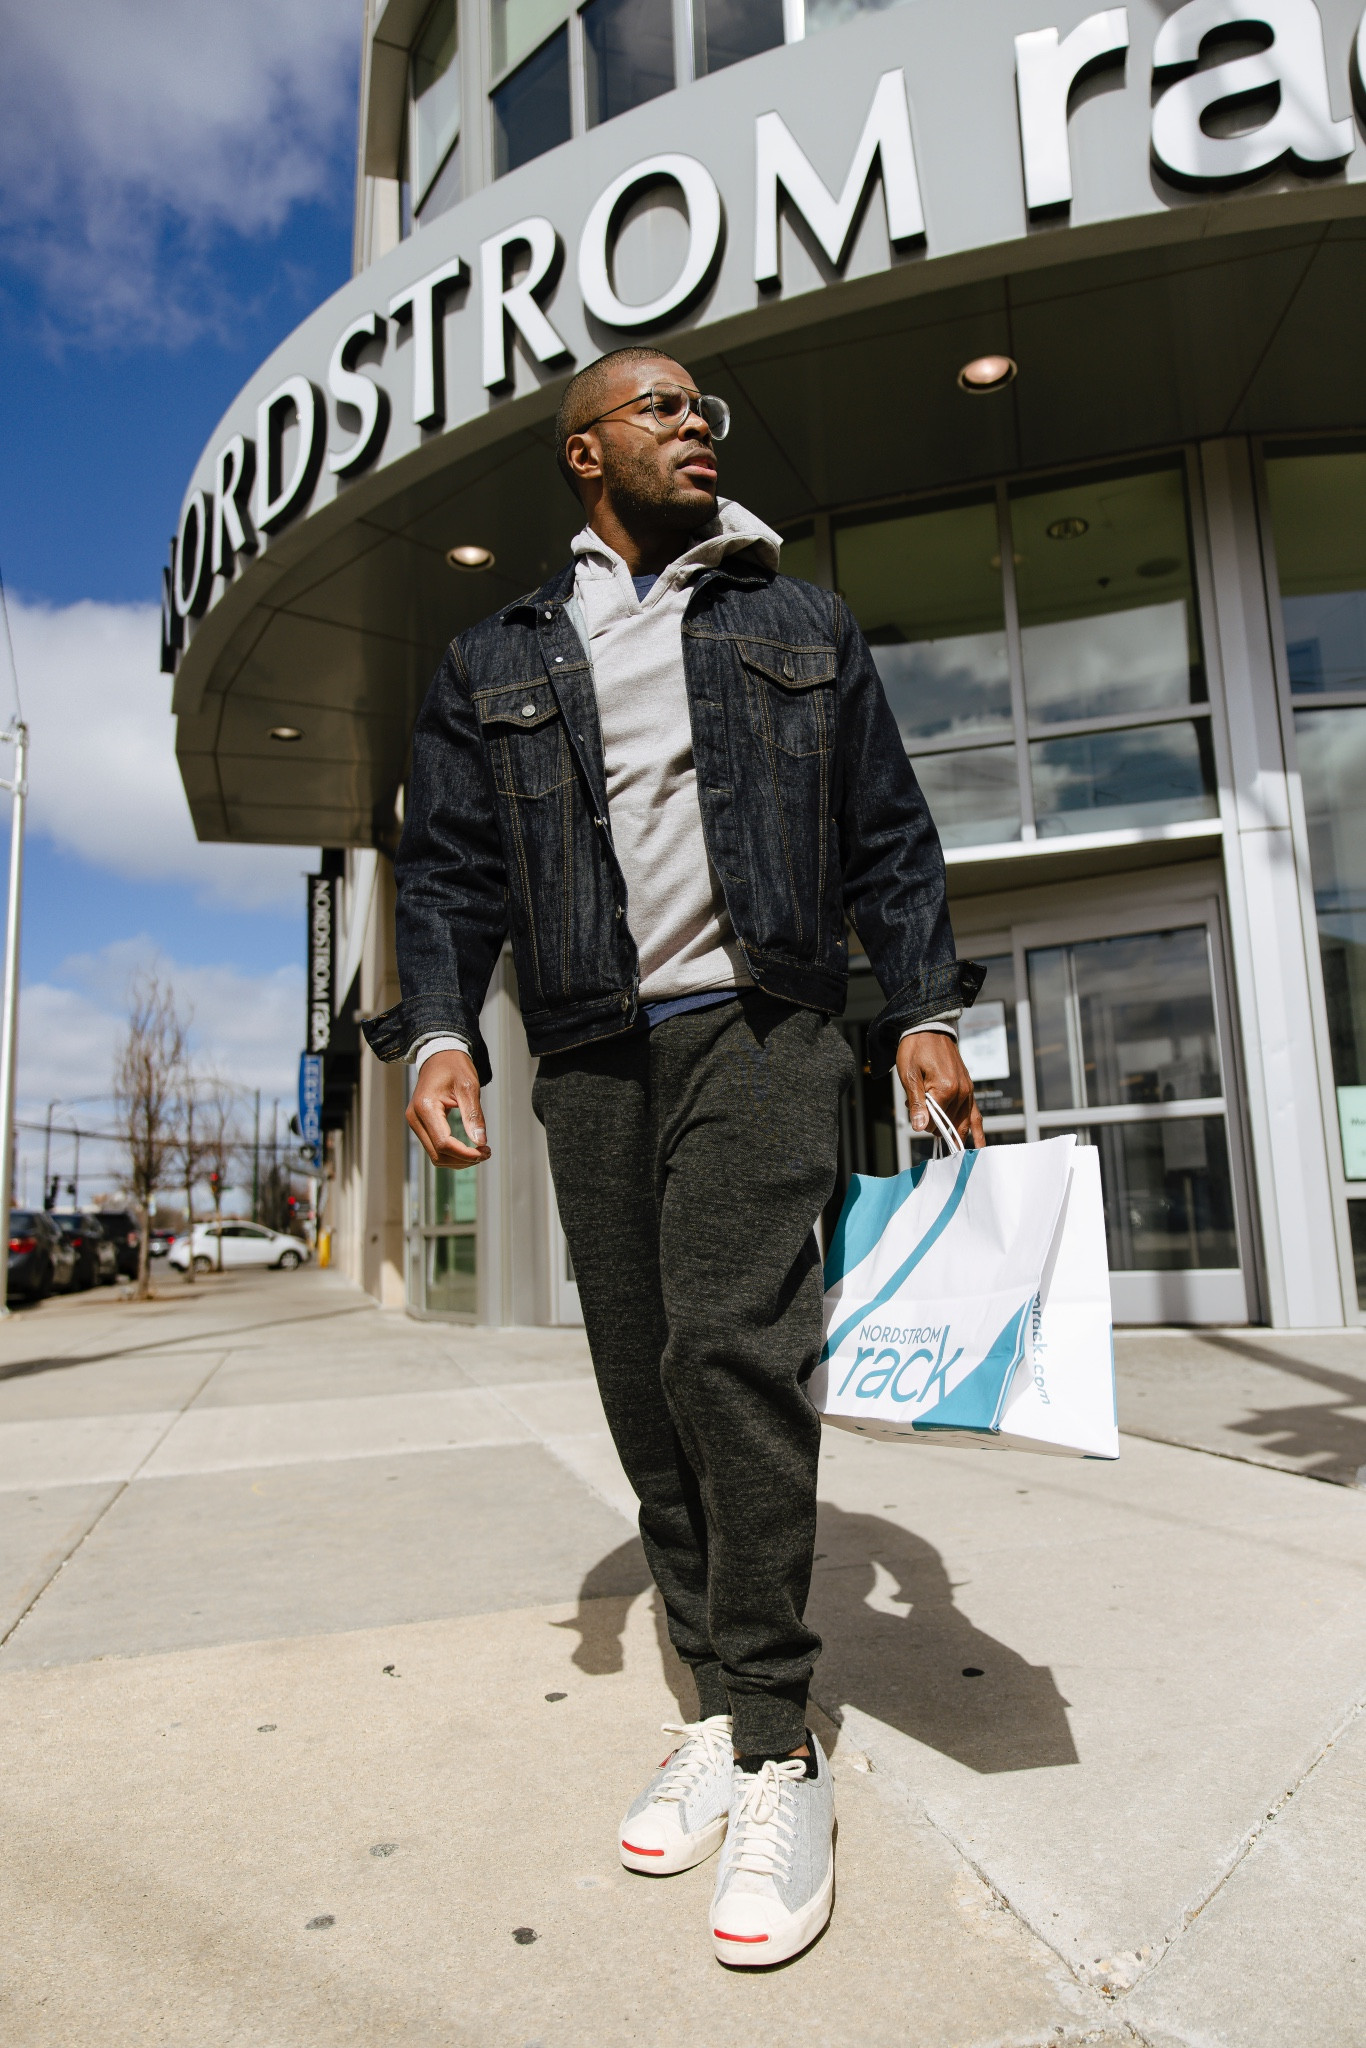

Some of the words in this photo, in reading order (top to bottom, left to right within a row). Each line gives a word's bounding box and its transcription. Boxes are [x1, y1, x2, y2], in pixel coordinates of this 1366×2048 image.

[161, 67, 927, 673] NORDSTROM
[1014, 0, 1366, 224] ra
[312, 879, 331, 999] NORDSTROM
[312, 1001, 331, 1051] rack
[837, 1325, 964, 1402] rack
[859, 1325, 942, 1344] NORDSTROM
